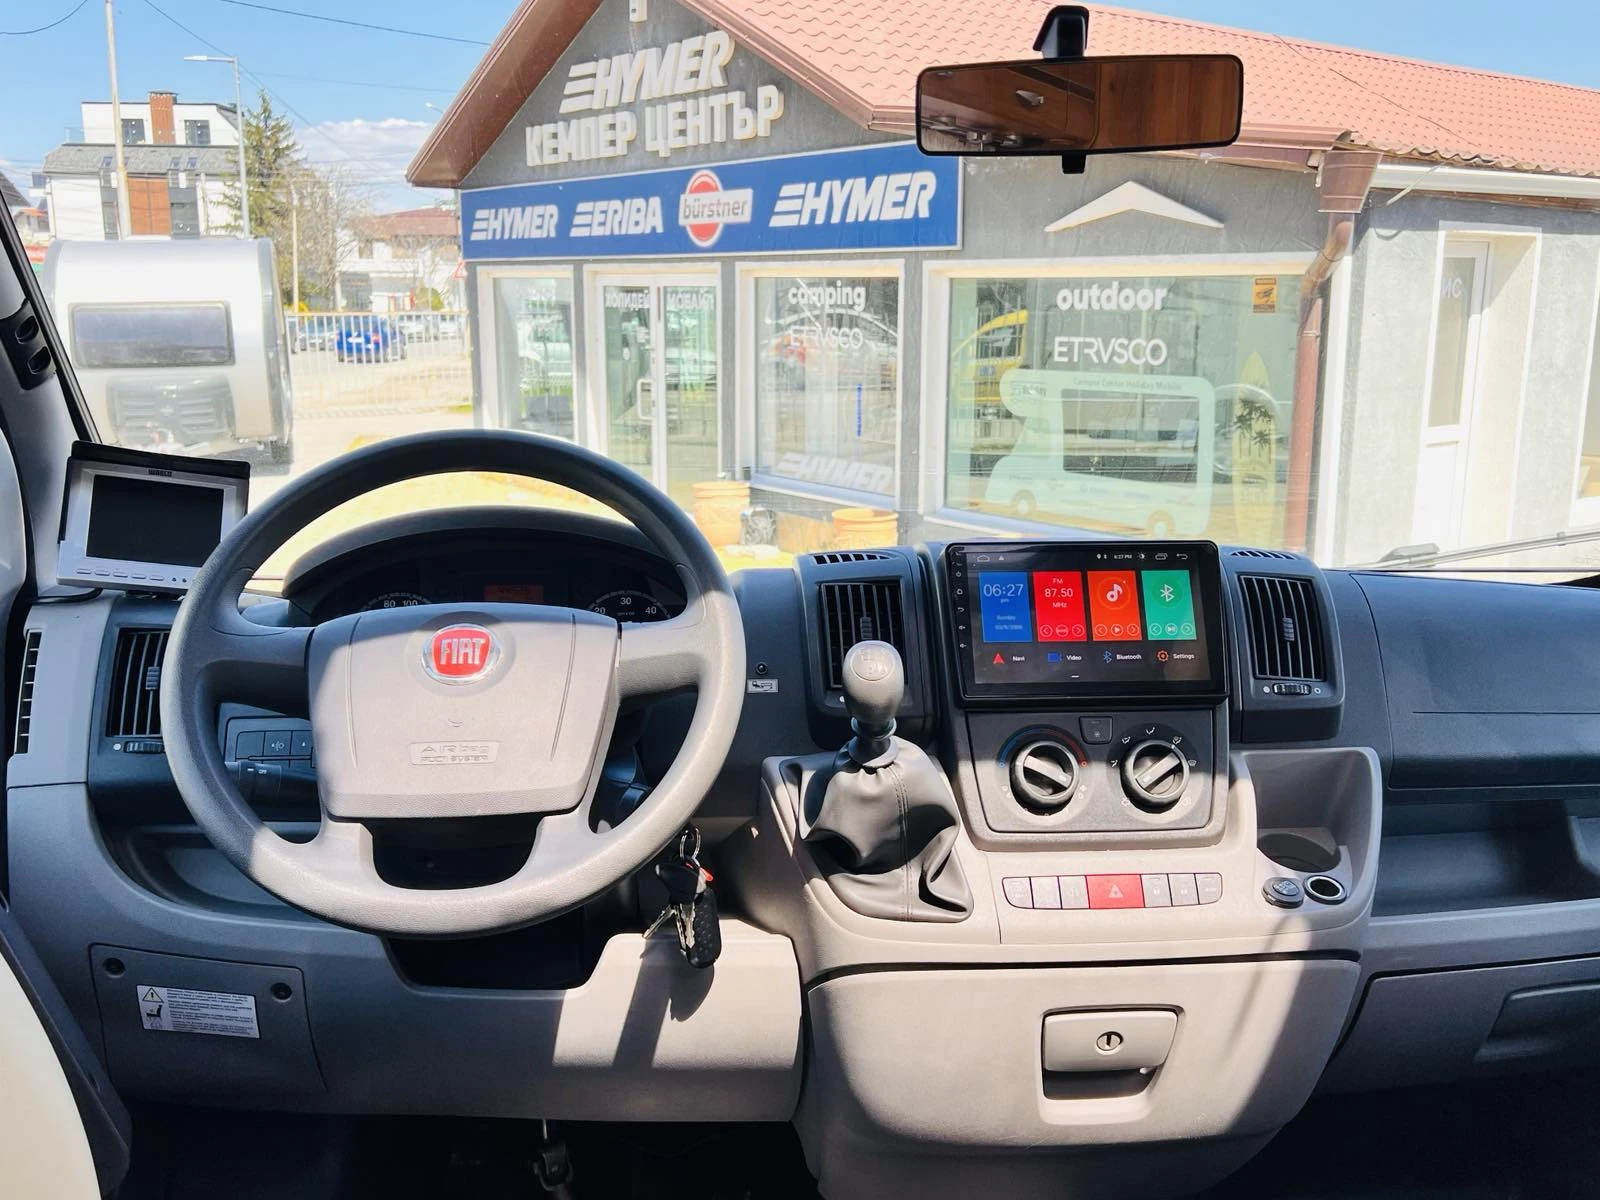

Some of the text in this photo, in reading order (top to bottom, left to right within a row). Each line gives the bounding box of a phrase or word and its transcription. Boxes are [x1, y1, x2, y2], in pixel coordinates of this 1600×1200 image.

[559, 30, 734, 114] HYMER
[525, 84, 784, 167] КЕМПЕР ЦЕНТЪР
[682, 197, 749, 220] bürstner
[768, 170, 937, 227] HYMER
[470, 205, 559, 240] HYMER
[569, 196, 664, 237] ERIBA
[788, 280, 867, 312] camping
[1056, 281, 1168, 311] outdoor
[383, 600, 396, 608] 80
[620, 597, 632, 605] 30
[983, 584, 1024, 597] 06:27
[1044, 588, 1073, 598] 87.50
[645, 606, 657, 614] 40
[440, 638, 486, 665] FIAT
[1173, 653, 1195, 661] Settings
